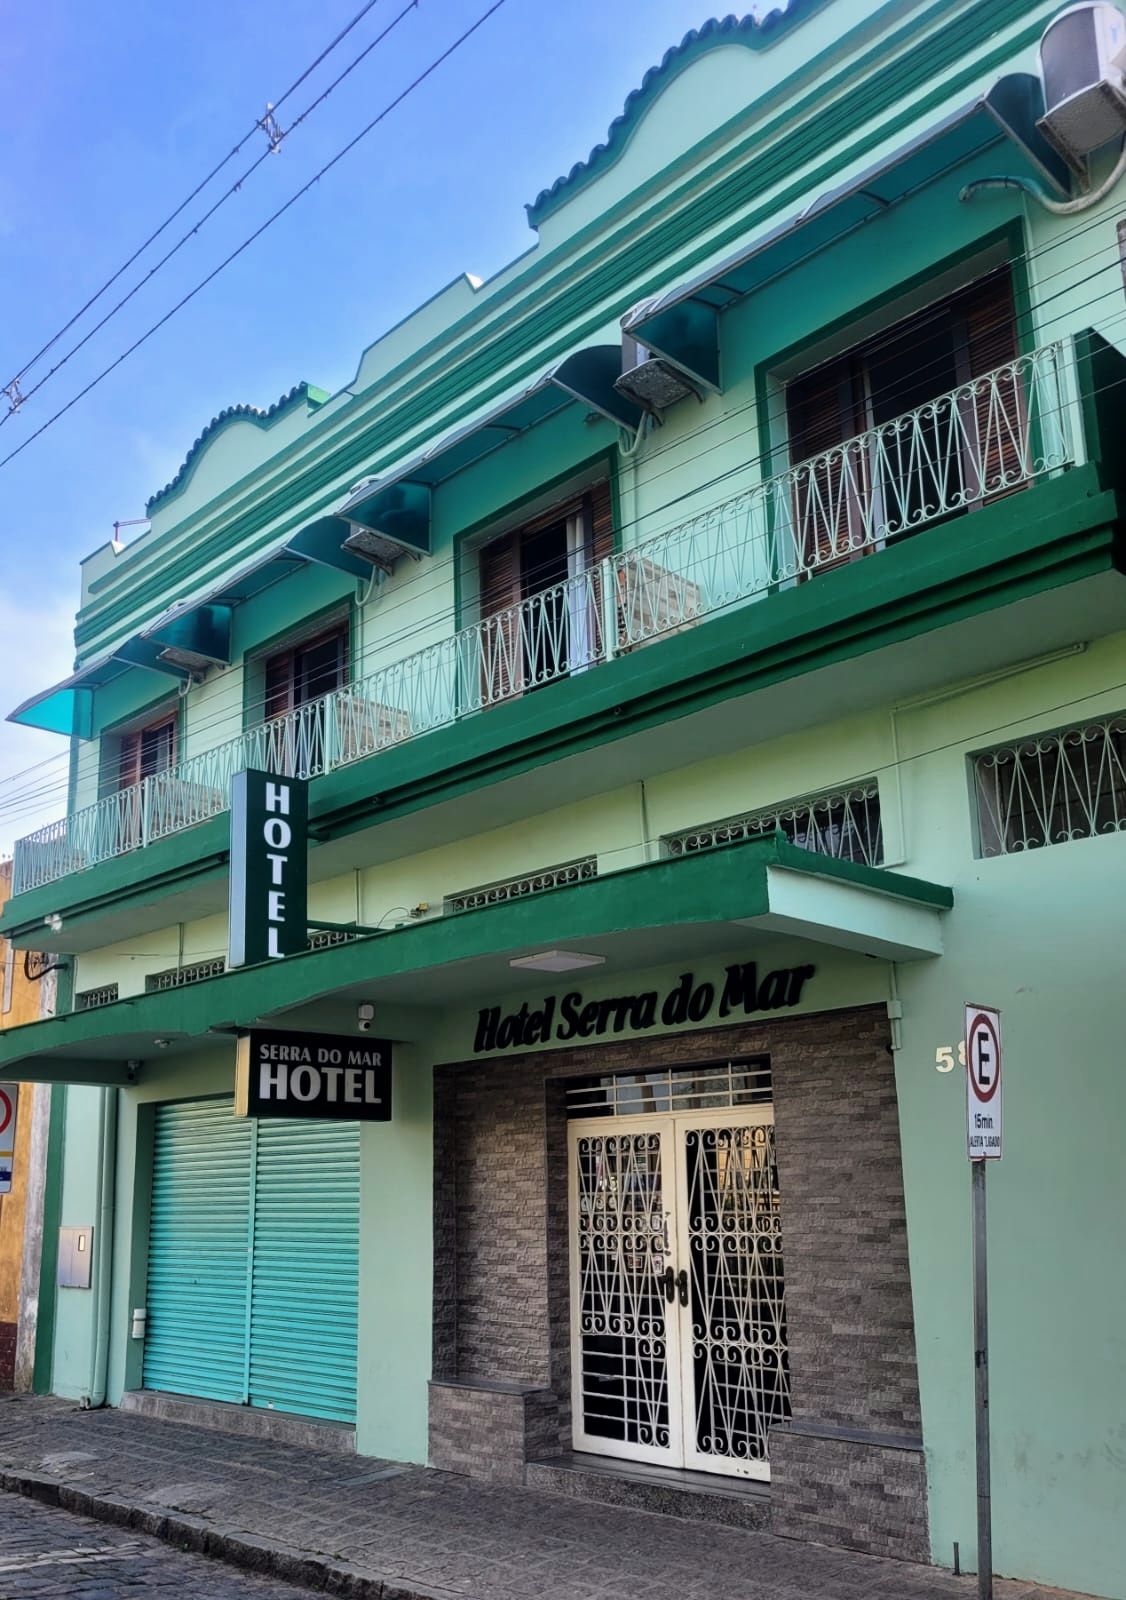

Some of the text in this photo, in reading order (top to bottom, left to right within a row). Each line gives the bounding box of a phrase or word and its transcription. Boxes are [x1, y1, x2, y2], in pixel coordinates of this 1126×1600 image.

[263, 781, 292, 959] HOTEL
[474, 961, 816, 1053] Hotel Serra do Mar
[259, 1043, 382, 1067] SERRA DO MAR
[977, 1031, 991, 1085] E
[258, 1063, 382, 1104] HOTEL
